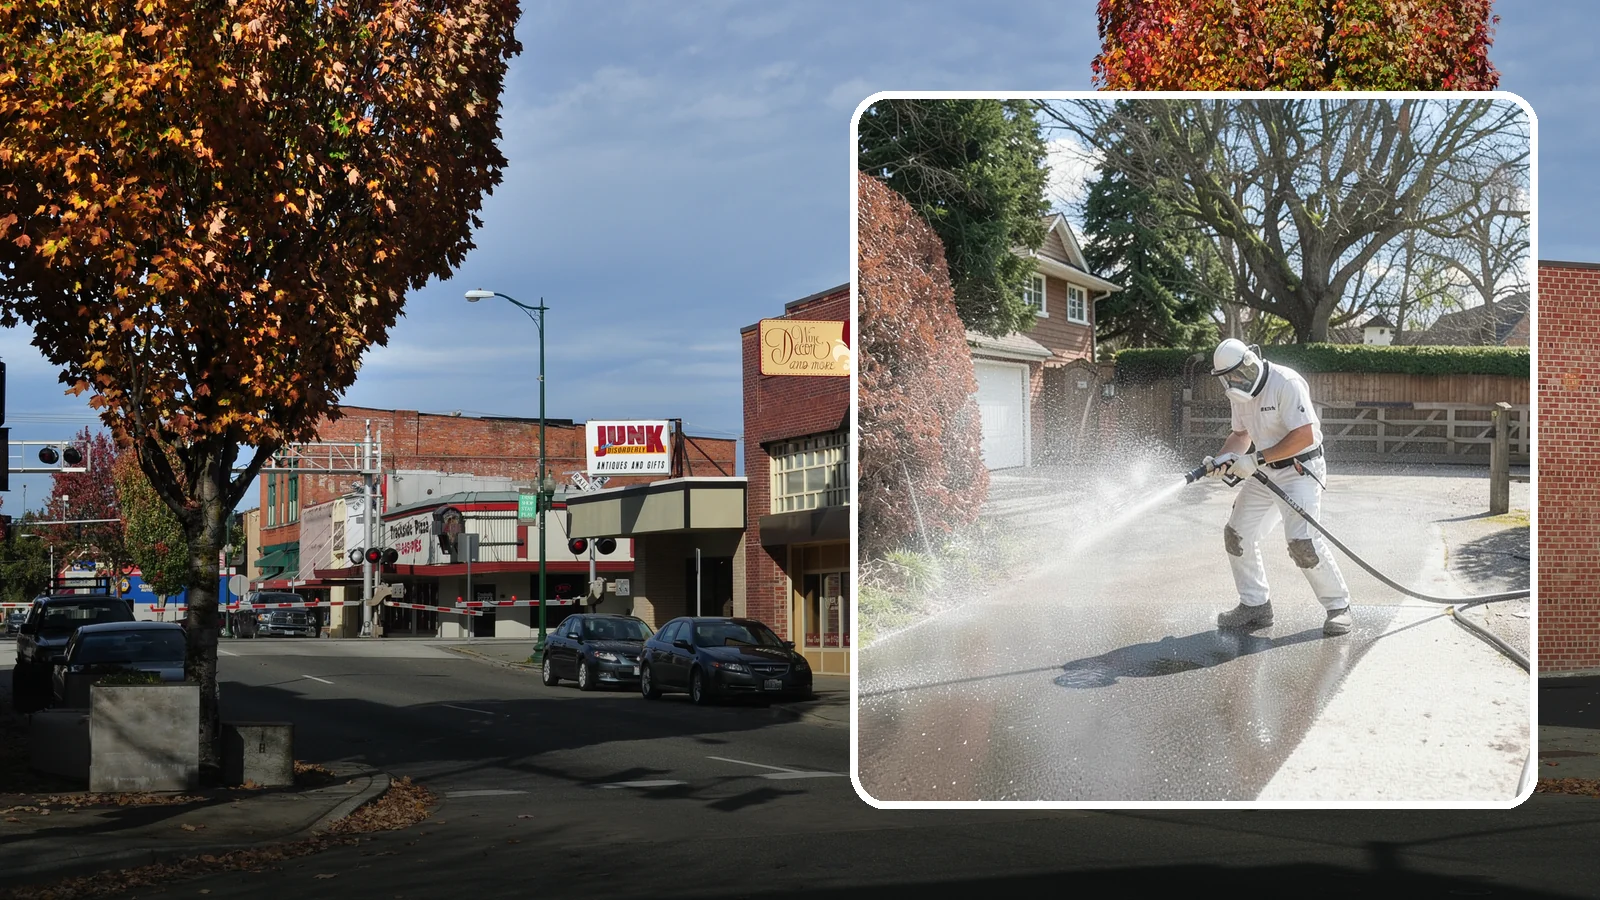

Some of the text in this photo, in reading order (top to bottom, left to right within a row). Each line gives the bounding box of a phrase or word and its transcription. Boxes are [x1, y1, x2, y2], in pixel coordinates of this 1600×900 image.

[595, 425, 665, 457] JUNK
[607, 446, 646, 454] DISORDERLY
[597, 460, 665, 470] ANTIQUES AND GIFTS
[352, 498, 365, 511] CRO
[390, 519, 429, 540] Trackside Pizza
